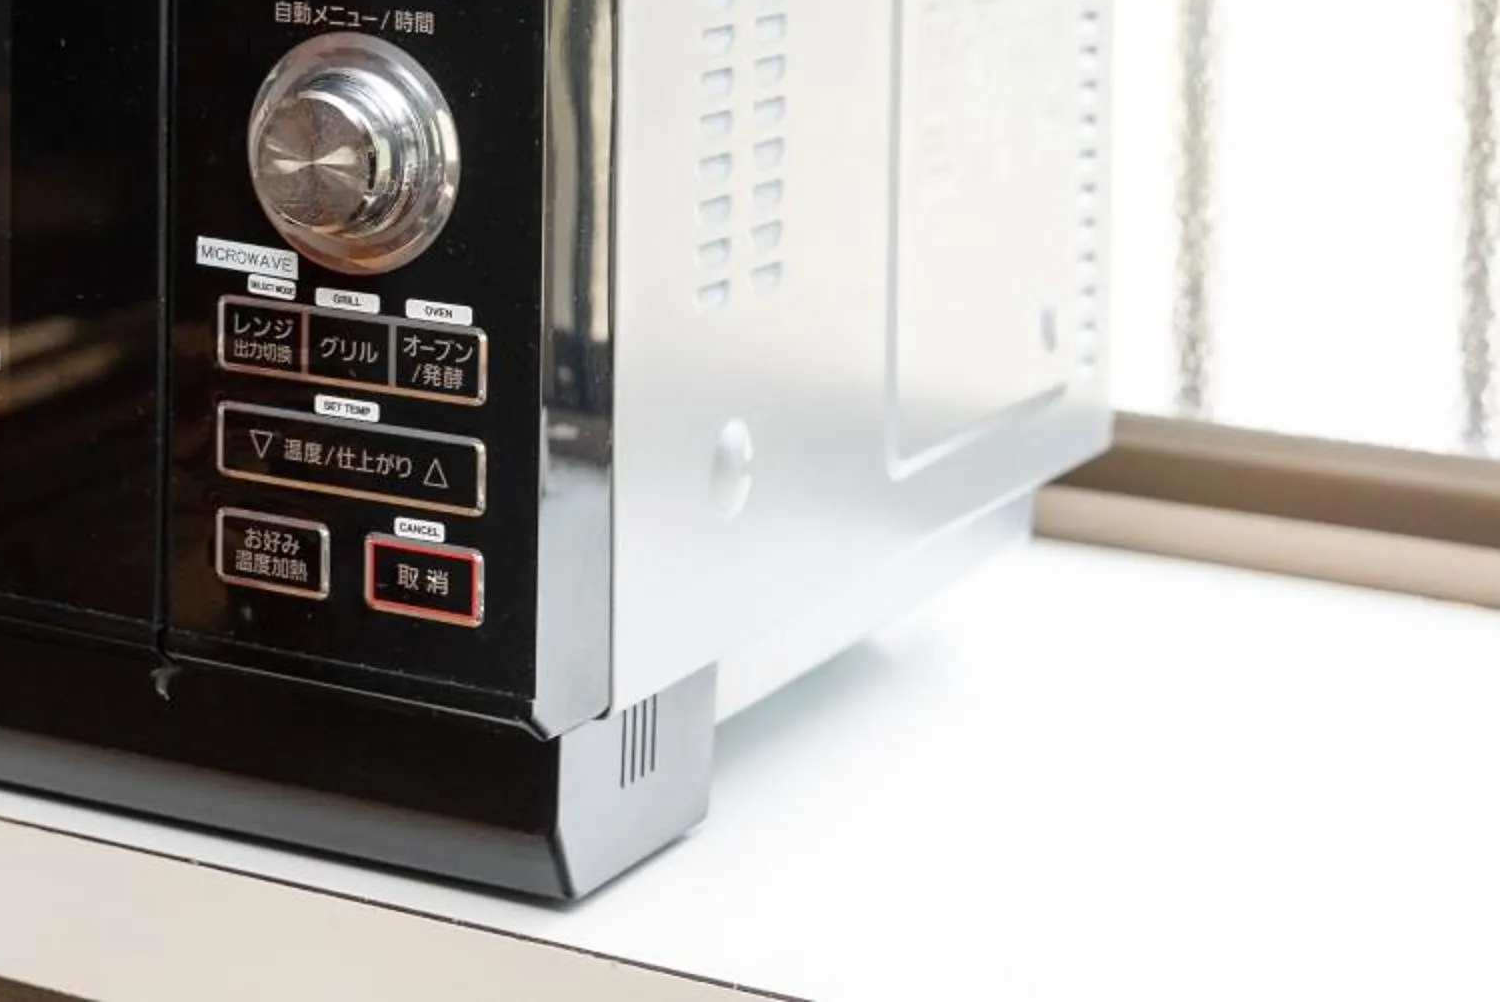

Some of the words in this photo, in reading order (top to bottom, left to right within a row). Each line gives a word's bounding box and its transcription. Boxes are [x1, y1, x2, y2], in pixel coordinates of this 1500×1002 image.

[274, 1, 436, 34] 自動メニュー/時間
[200, 244, 294, 273] MICROWAVE
[333, 293, 363, 307] GRILL
[424, 305, 453, 319] OVEN
[233, 311, 294, 339] レンジ
[233, 339, 293, 366] 出力切換
[319, 336, 379, 364] グリル
[403, 334, 473, 363] オーブン
[411, 363, 464, 391] /発酵
[284, 438, 412, 478] 温度/仕上がり
[244, 527, 301, 555] お好み
[399, 522, 441, 537] CANCEL
[235, 549, 308, 582] 温度加熱
